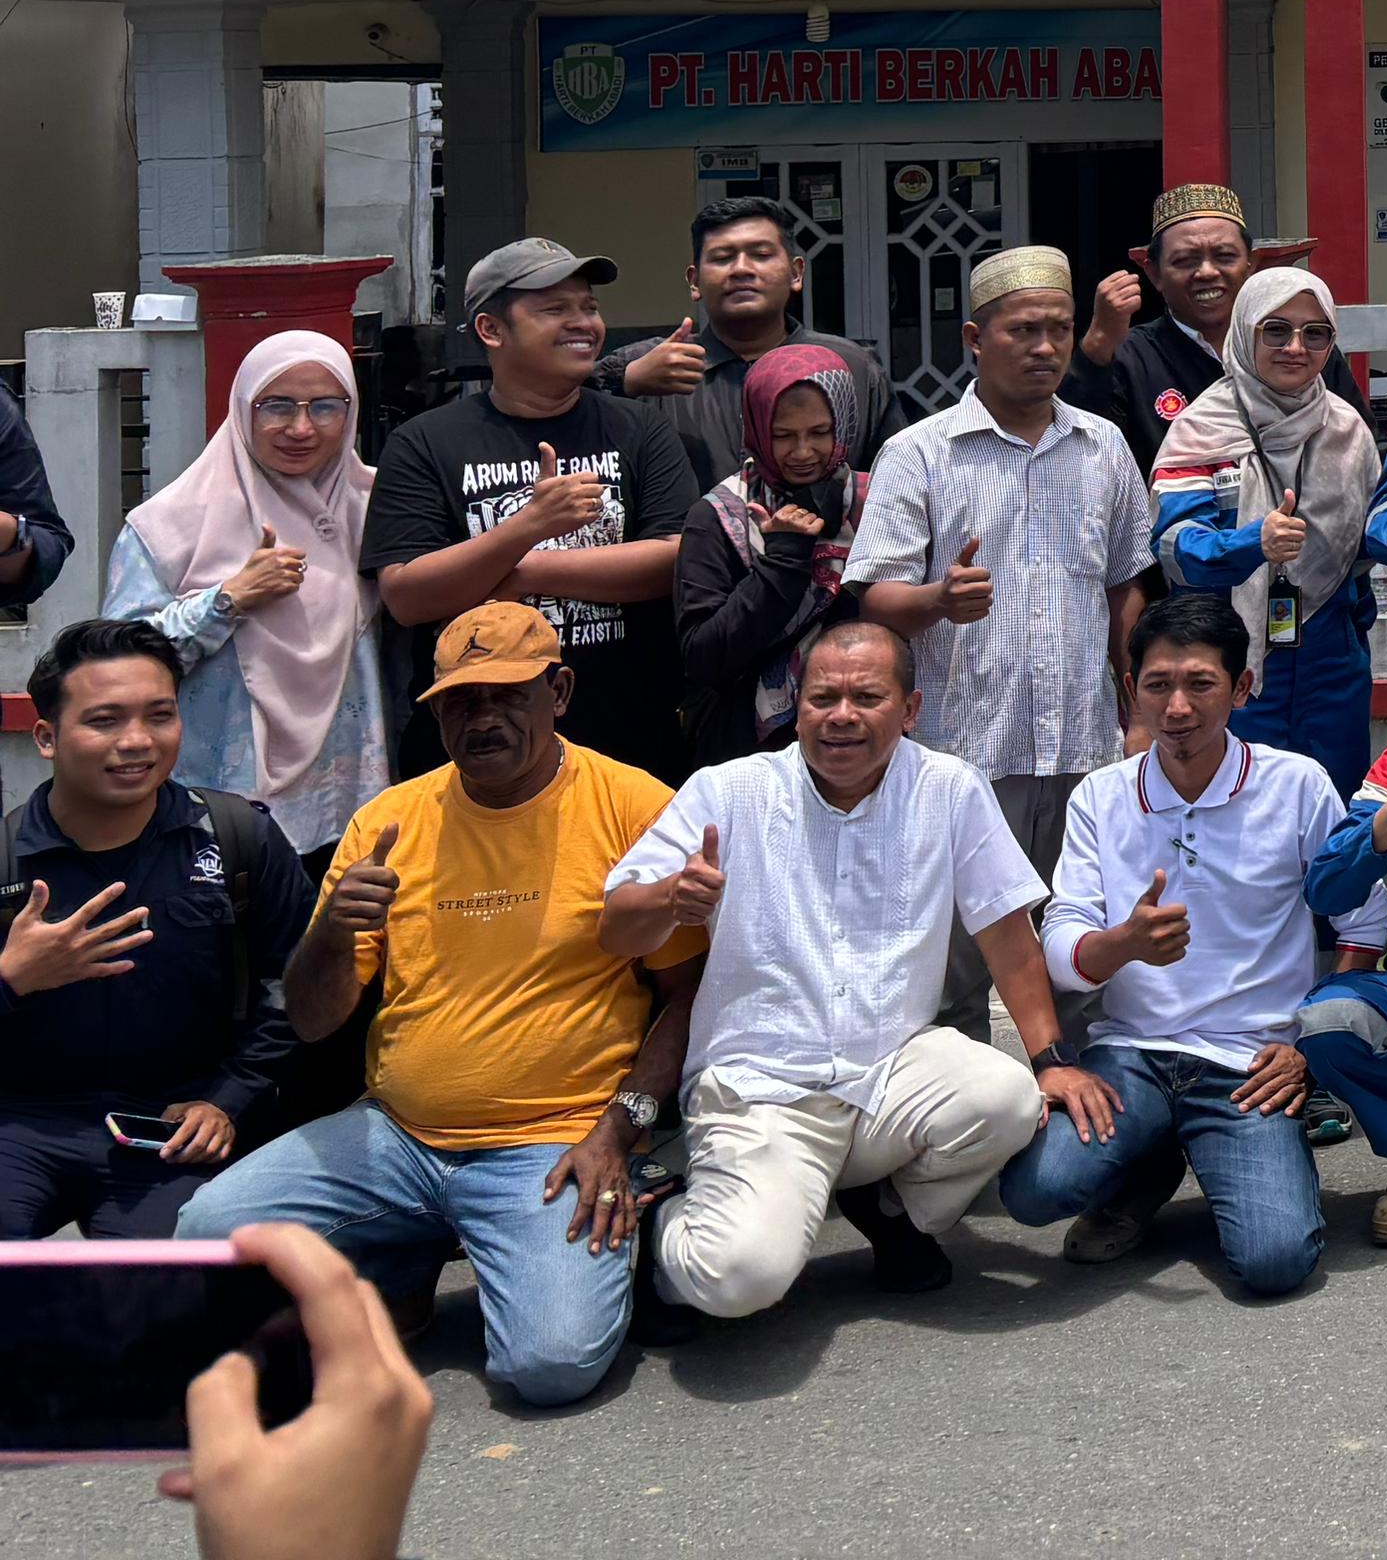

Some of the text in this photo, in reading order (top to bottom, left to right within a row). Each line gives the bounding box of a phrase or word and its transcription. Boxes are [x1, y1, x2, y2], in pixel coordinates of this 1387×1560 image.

[580, 45, 597, 56] PT
[648, 47, 1163, 108] PT. HARTI BERKAH ABA
[462, 461, 518, 495] ARUM
[572, 621, 612, 648] EXIST
[437, 890, 541, 911] STREET STYLE
